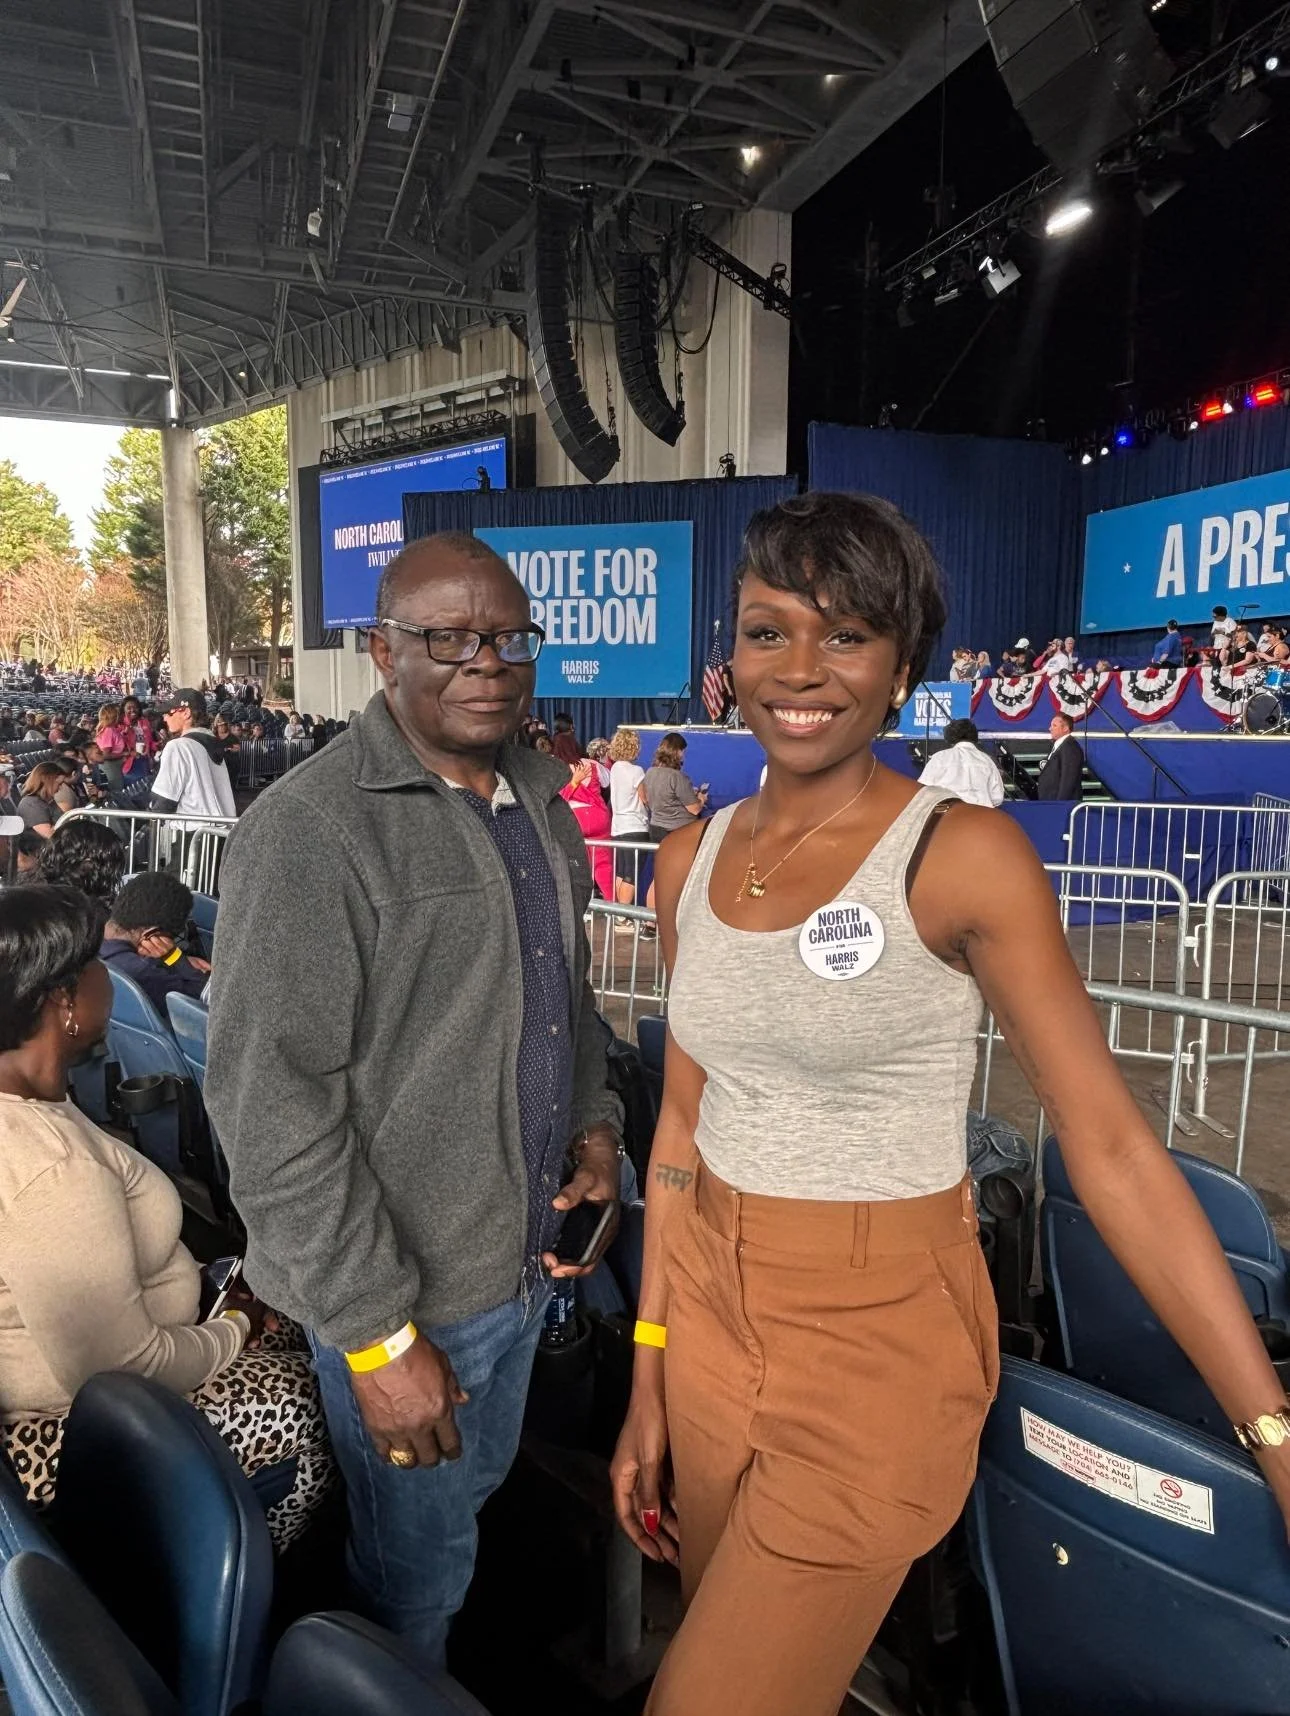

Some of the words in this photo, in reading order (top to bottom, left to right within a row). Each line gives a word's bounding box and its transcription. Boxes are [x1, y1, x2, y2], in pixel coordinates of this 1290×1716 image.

[334, 525, 367, 550] NORTH
[369, 520, 404, 545] CAROL
[1156, 523, 1185, 598] A
[1197, 502, 1290, 593] PRE
[507, 550, 585, 598] VOTE
[594, 547, 658, 597] FOR
[530, 597, 657, 645] REEDOM
[561, 660, 600, 674] HARRIS
[567, 674, 594, 684] WALZ
[915, 698, 952, 718] VOTES
[817, 907, 861, 928] NORTH
[808, 921, 873, 945] CAROLINA
[825, 951, 859, 966] HARRIS
[831, 963, 855, 972] WALZ
[1027, 1416, 1046, 1431] HOW
[1048, 1428, 1065, 1442] MAY
[1067, 1437, 1081, 1450] WE
[1083, 1445, 1103, 1460] HELP
[1106, 1456, 1131, 1473] YOU?
[1029, 1425, 1045, 1439] TEXT
[1046, 1435, 1067, 1451] YOUR
[1068, 1447, 1109, 1471] LOCATION
[1112, 1468, 1130, 1480] AND
[1061, 1451, 1072, 1461] TO
